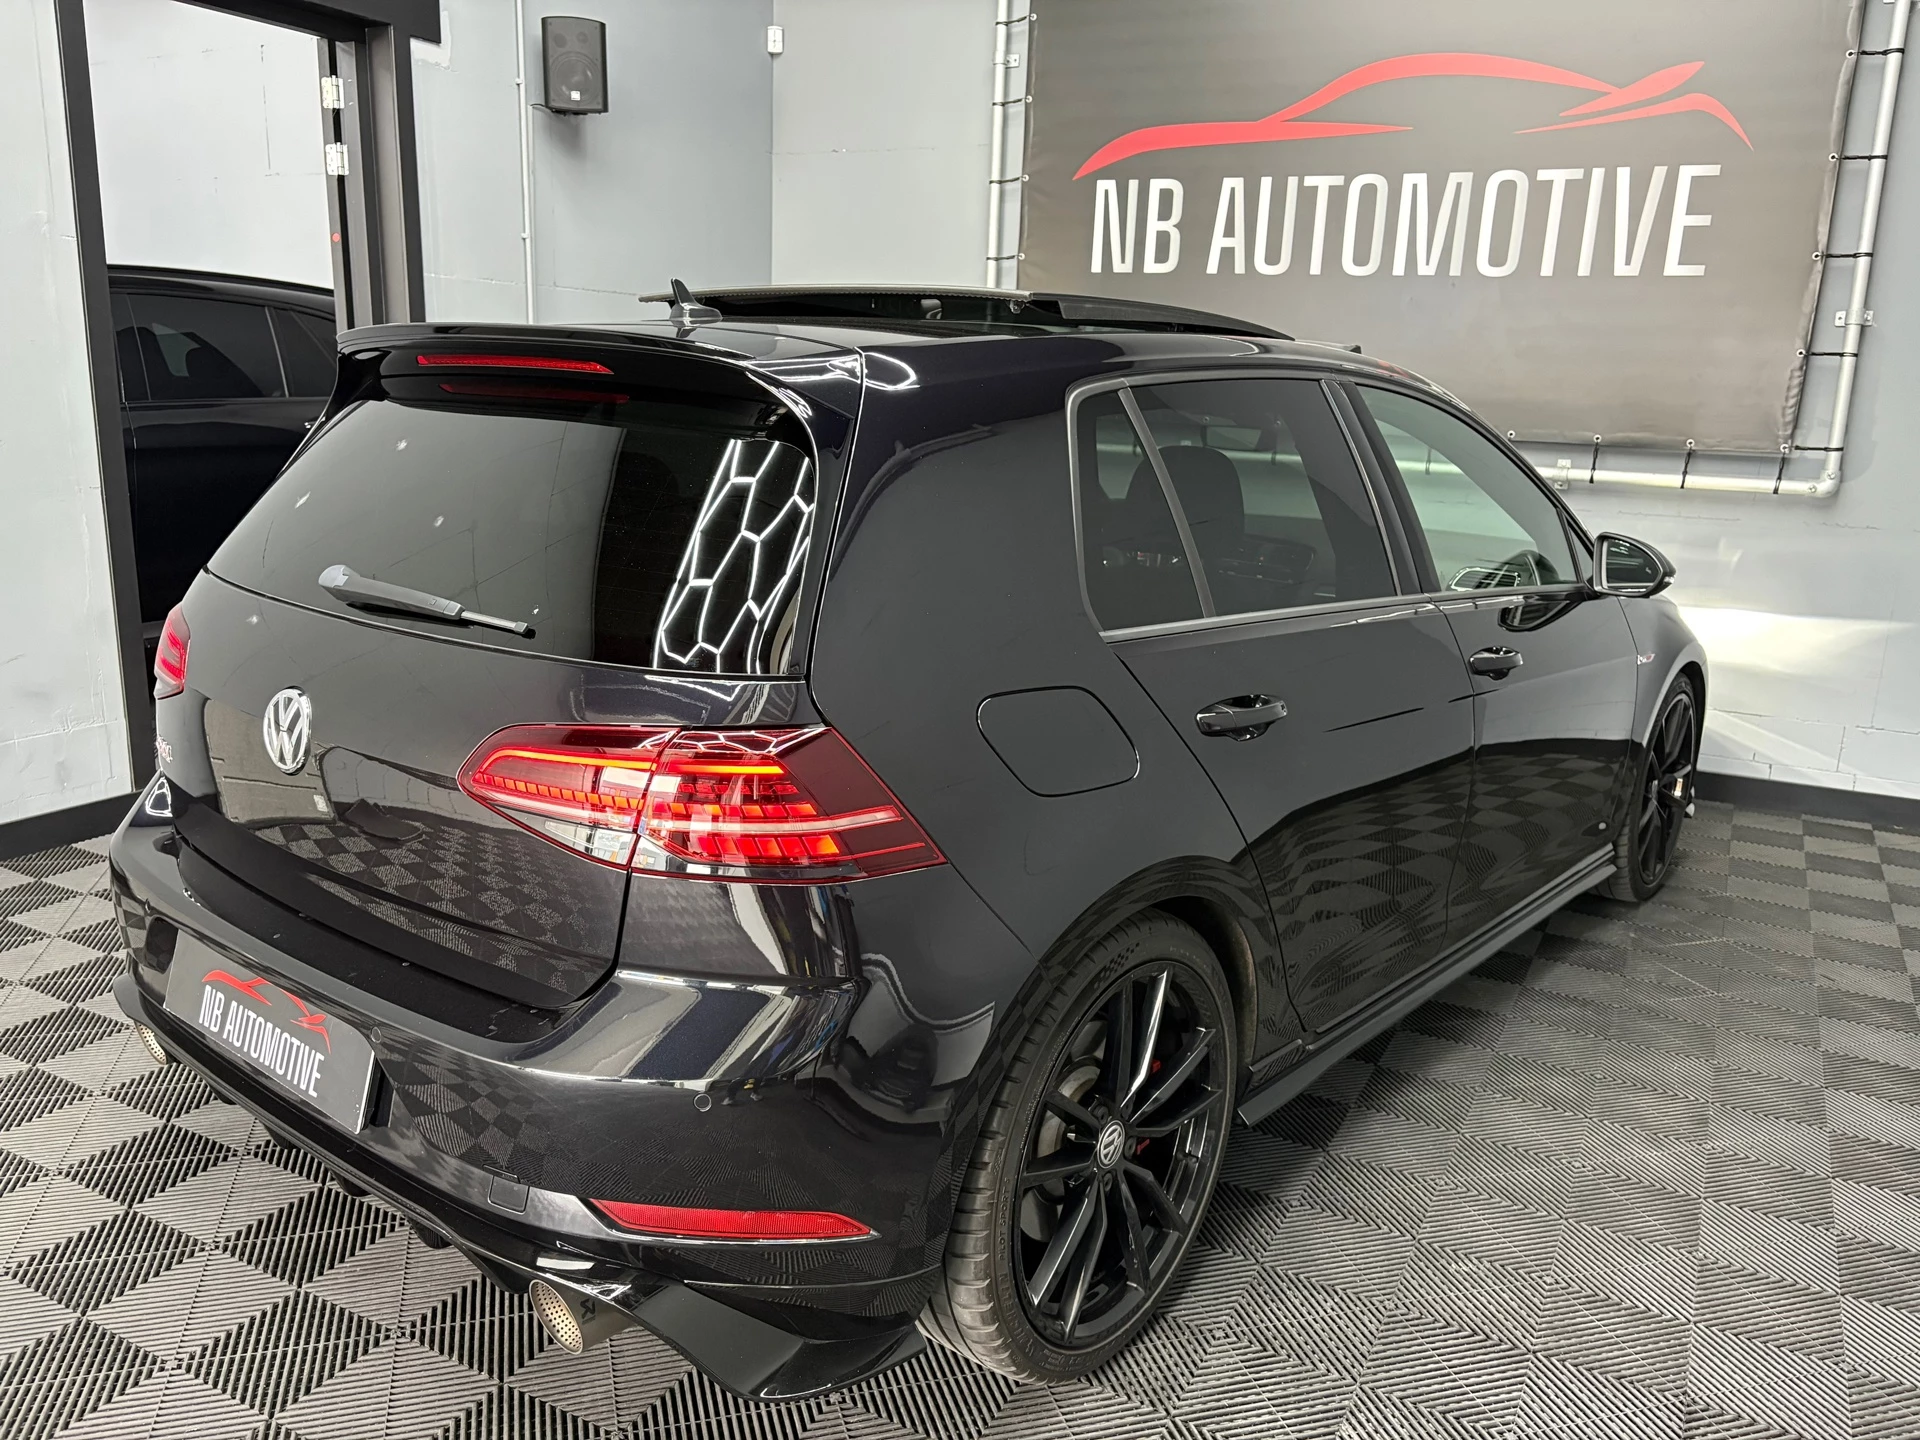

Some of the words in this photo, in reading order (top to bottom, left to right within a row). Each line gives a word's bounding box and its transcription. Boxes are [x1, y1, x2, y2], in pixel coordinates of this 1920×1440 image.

[1090, 178, 1185, 274] NB
[1206, 164, 1722, 278] AUTOMOTIVE
[199, 984, 226, 1034] NB
[222, 1000, 326, 1098] AUTOMOTIVE
